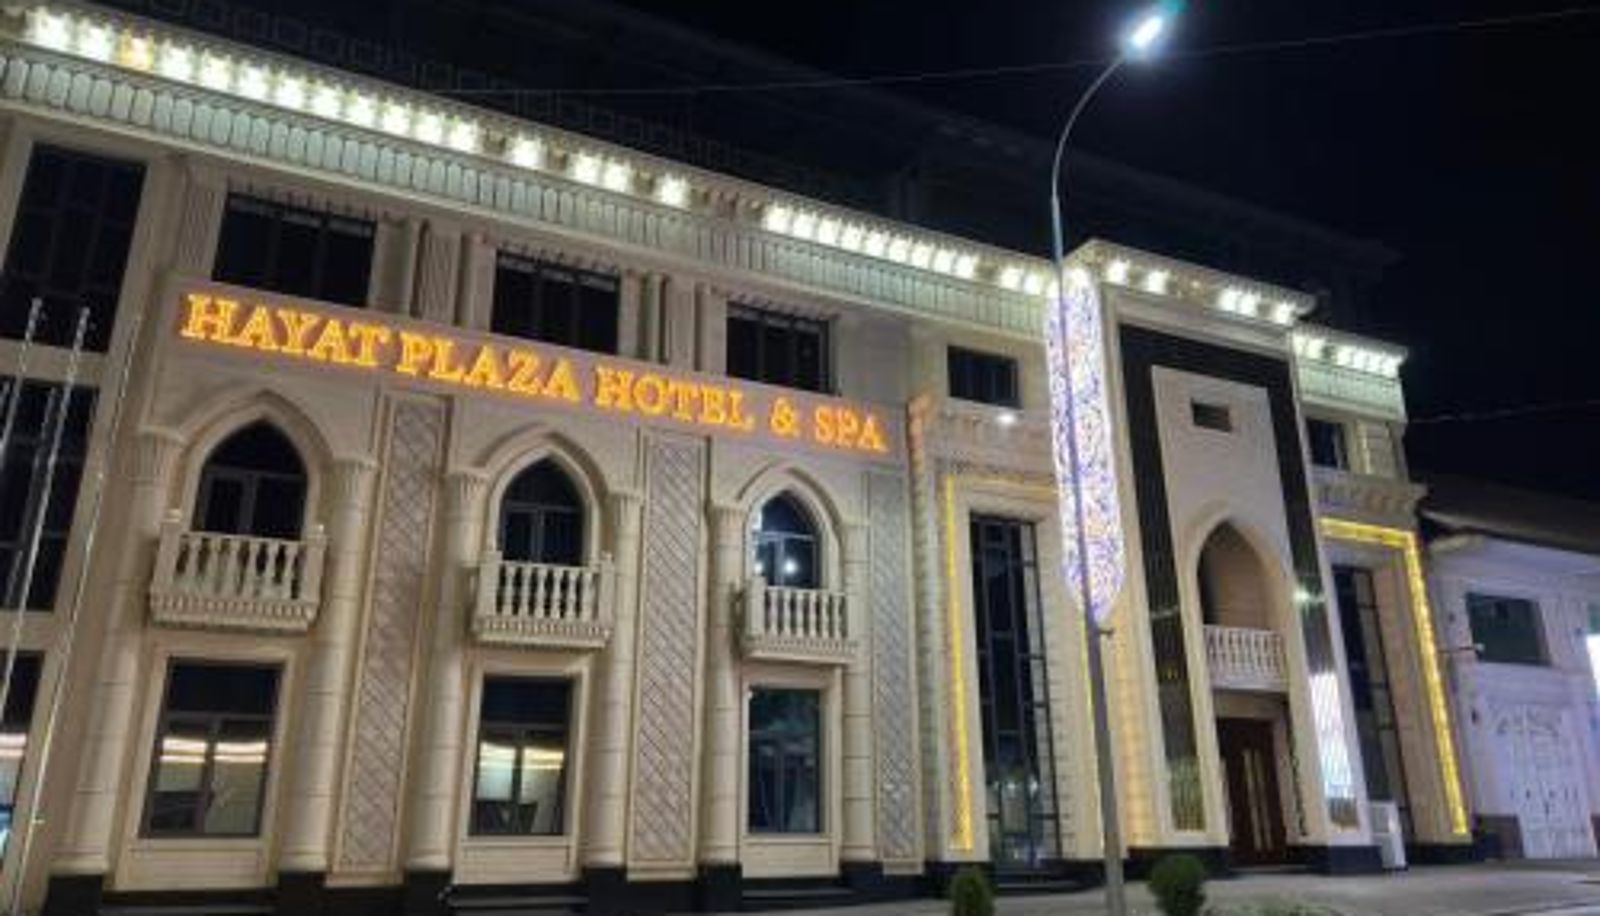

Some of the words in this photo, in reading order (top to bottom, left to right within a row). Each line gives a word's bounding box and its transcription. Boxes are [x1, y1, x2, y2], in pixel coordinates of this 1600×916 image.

[181, 294, 388, 366] HAYAT
[396, 331, 580, 403] PLAZA
[595, 364, 754, 431] HOTEL
[769, 397, 799, 437] &
[814, 405, 887, 452] SPA
